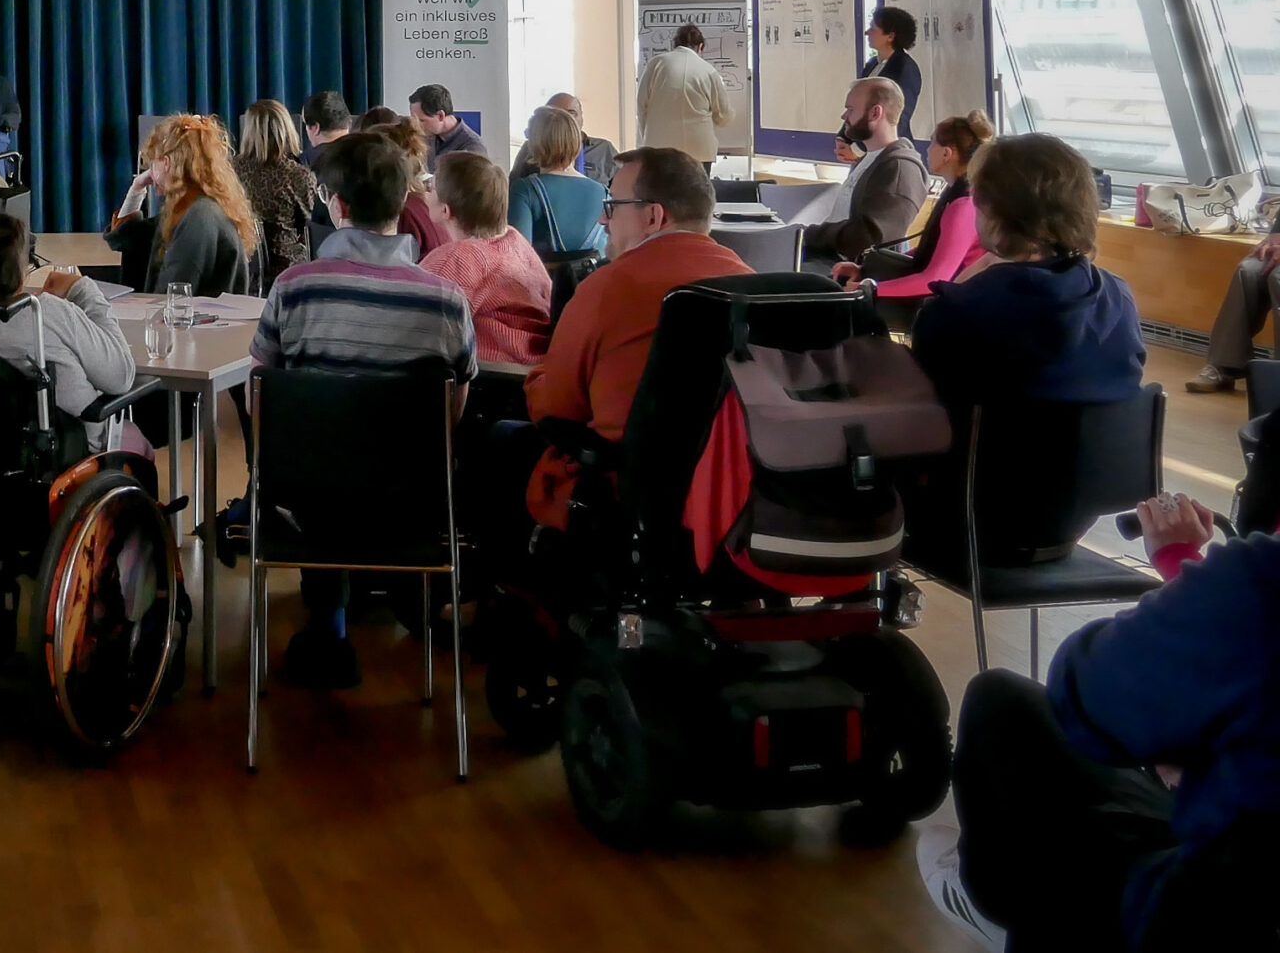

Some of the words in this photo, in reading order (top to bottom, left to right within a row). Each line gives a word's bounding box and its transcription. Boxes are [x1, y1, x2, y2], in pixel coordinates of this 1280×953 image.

[395, 11, 418, 22] ein
[422, 10, 497, 22] inklusives
[404, 27, 450, 40] Leben
[453, 27, 489, 43] groß
[415, 47, 477, 59] denken.
